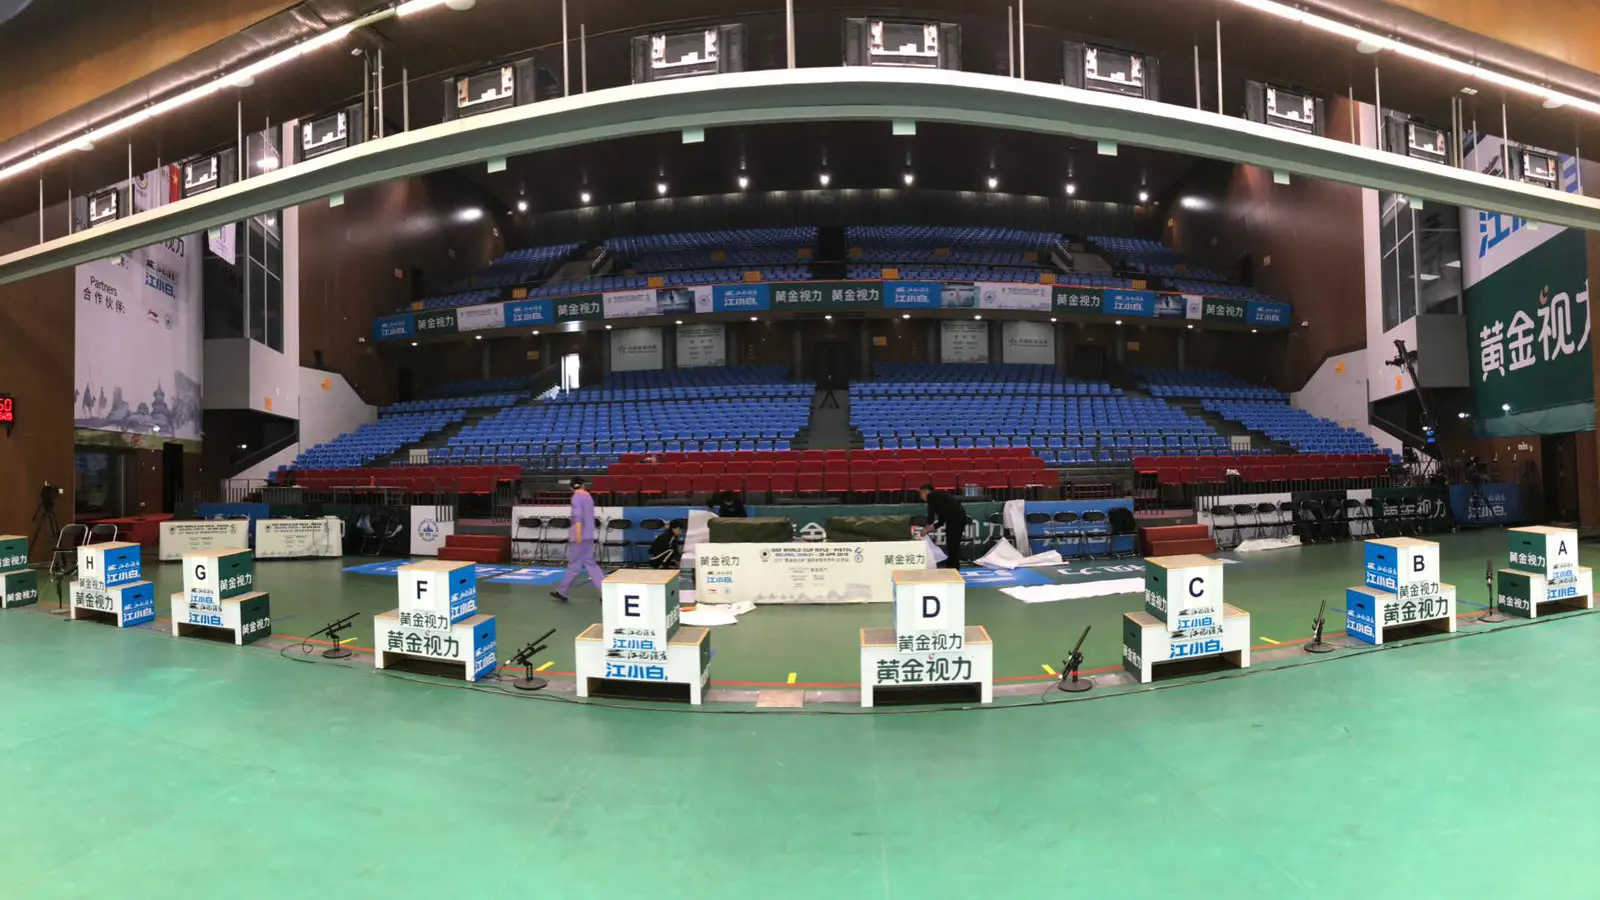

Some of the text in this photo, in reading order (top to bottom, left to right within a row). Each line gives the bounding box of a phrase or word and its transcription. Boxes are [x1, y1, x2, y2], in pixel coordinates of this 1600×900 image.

[90, 275, 118, 297] Partners
[775, 290, 821, 302] 黄金视力
[831, 288, 879, 302] 黄金视力
[1056, 293, 1100, 308] 黄金视力
[557, 302, 600, 316] 黄金视力
[1205, 303, 1244, 318] 黄金视力
[417, 315, 454, 330] 黄金视力
[1558, 540, 1567, 556] A
[86, 556, 94, 569] H
[700, 556, 740, 566] 黄金视力
[885, 554, 925, 565] 黄金视力
[1413, 555, 1425, 572] B
[1510, 551, 1545, 568] 黄金视力
[107, 569, 138, 583] 江小白
[195, 564, 206, 580] G
[1367, 572, 1395, 588] 江小白
[1553, 570, 1572, 579] 江小白
[79, 578, 105, 591] 黄金视力
[220, 573, 252, 592] 黄金视力
[416, 580, 428, 599] F
[1188, 577, 1204, 598] C
[1400, 582, 1439, 598] 黄金视力
[7, 589, 37, 602] 黄金视力
[75, 591, 114, 610] 黄金视力
[190, 595, 213, 604] 江小白
[1547, 586, 1576, 600] 江小白
[451, 599, 475, 620] 江小白
[624, 595, 640, 617] E
[922, 595, 941, 618] D
[1384, 597, 1448, 625] 黄金视力
[1499, 595, 1530, 611] 黄金视力
[123, 609, 152, 622] 江小白
[189, 612, 221, 625] 江小白
[400, 612, 448, 630] 黄金视力
[1177, 617, 1212, 629] 江小白
[242, 617, 270, 635] 黄金视力
[1347, 619, 1372, 635] 江小白
[387, 629, 460, 658] 黄金视力
[613, 639, 653, 650] 江小白
[898, 633, 962, 652] 黄金视力
[1169, 640, 1221, 658] 江小白
[475, 652, 496, 673] 江小白
[876, 656, 972, 684] 黄金视力
[605, 662, 664, 680] 江小白
